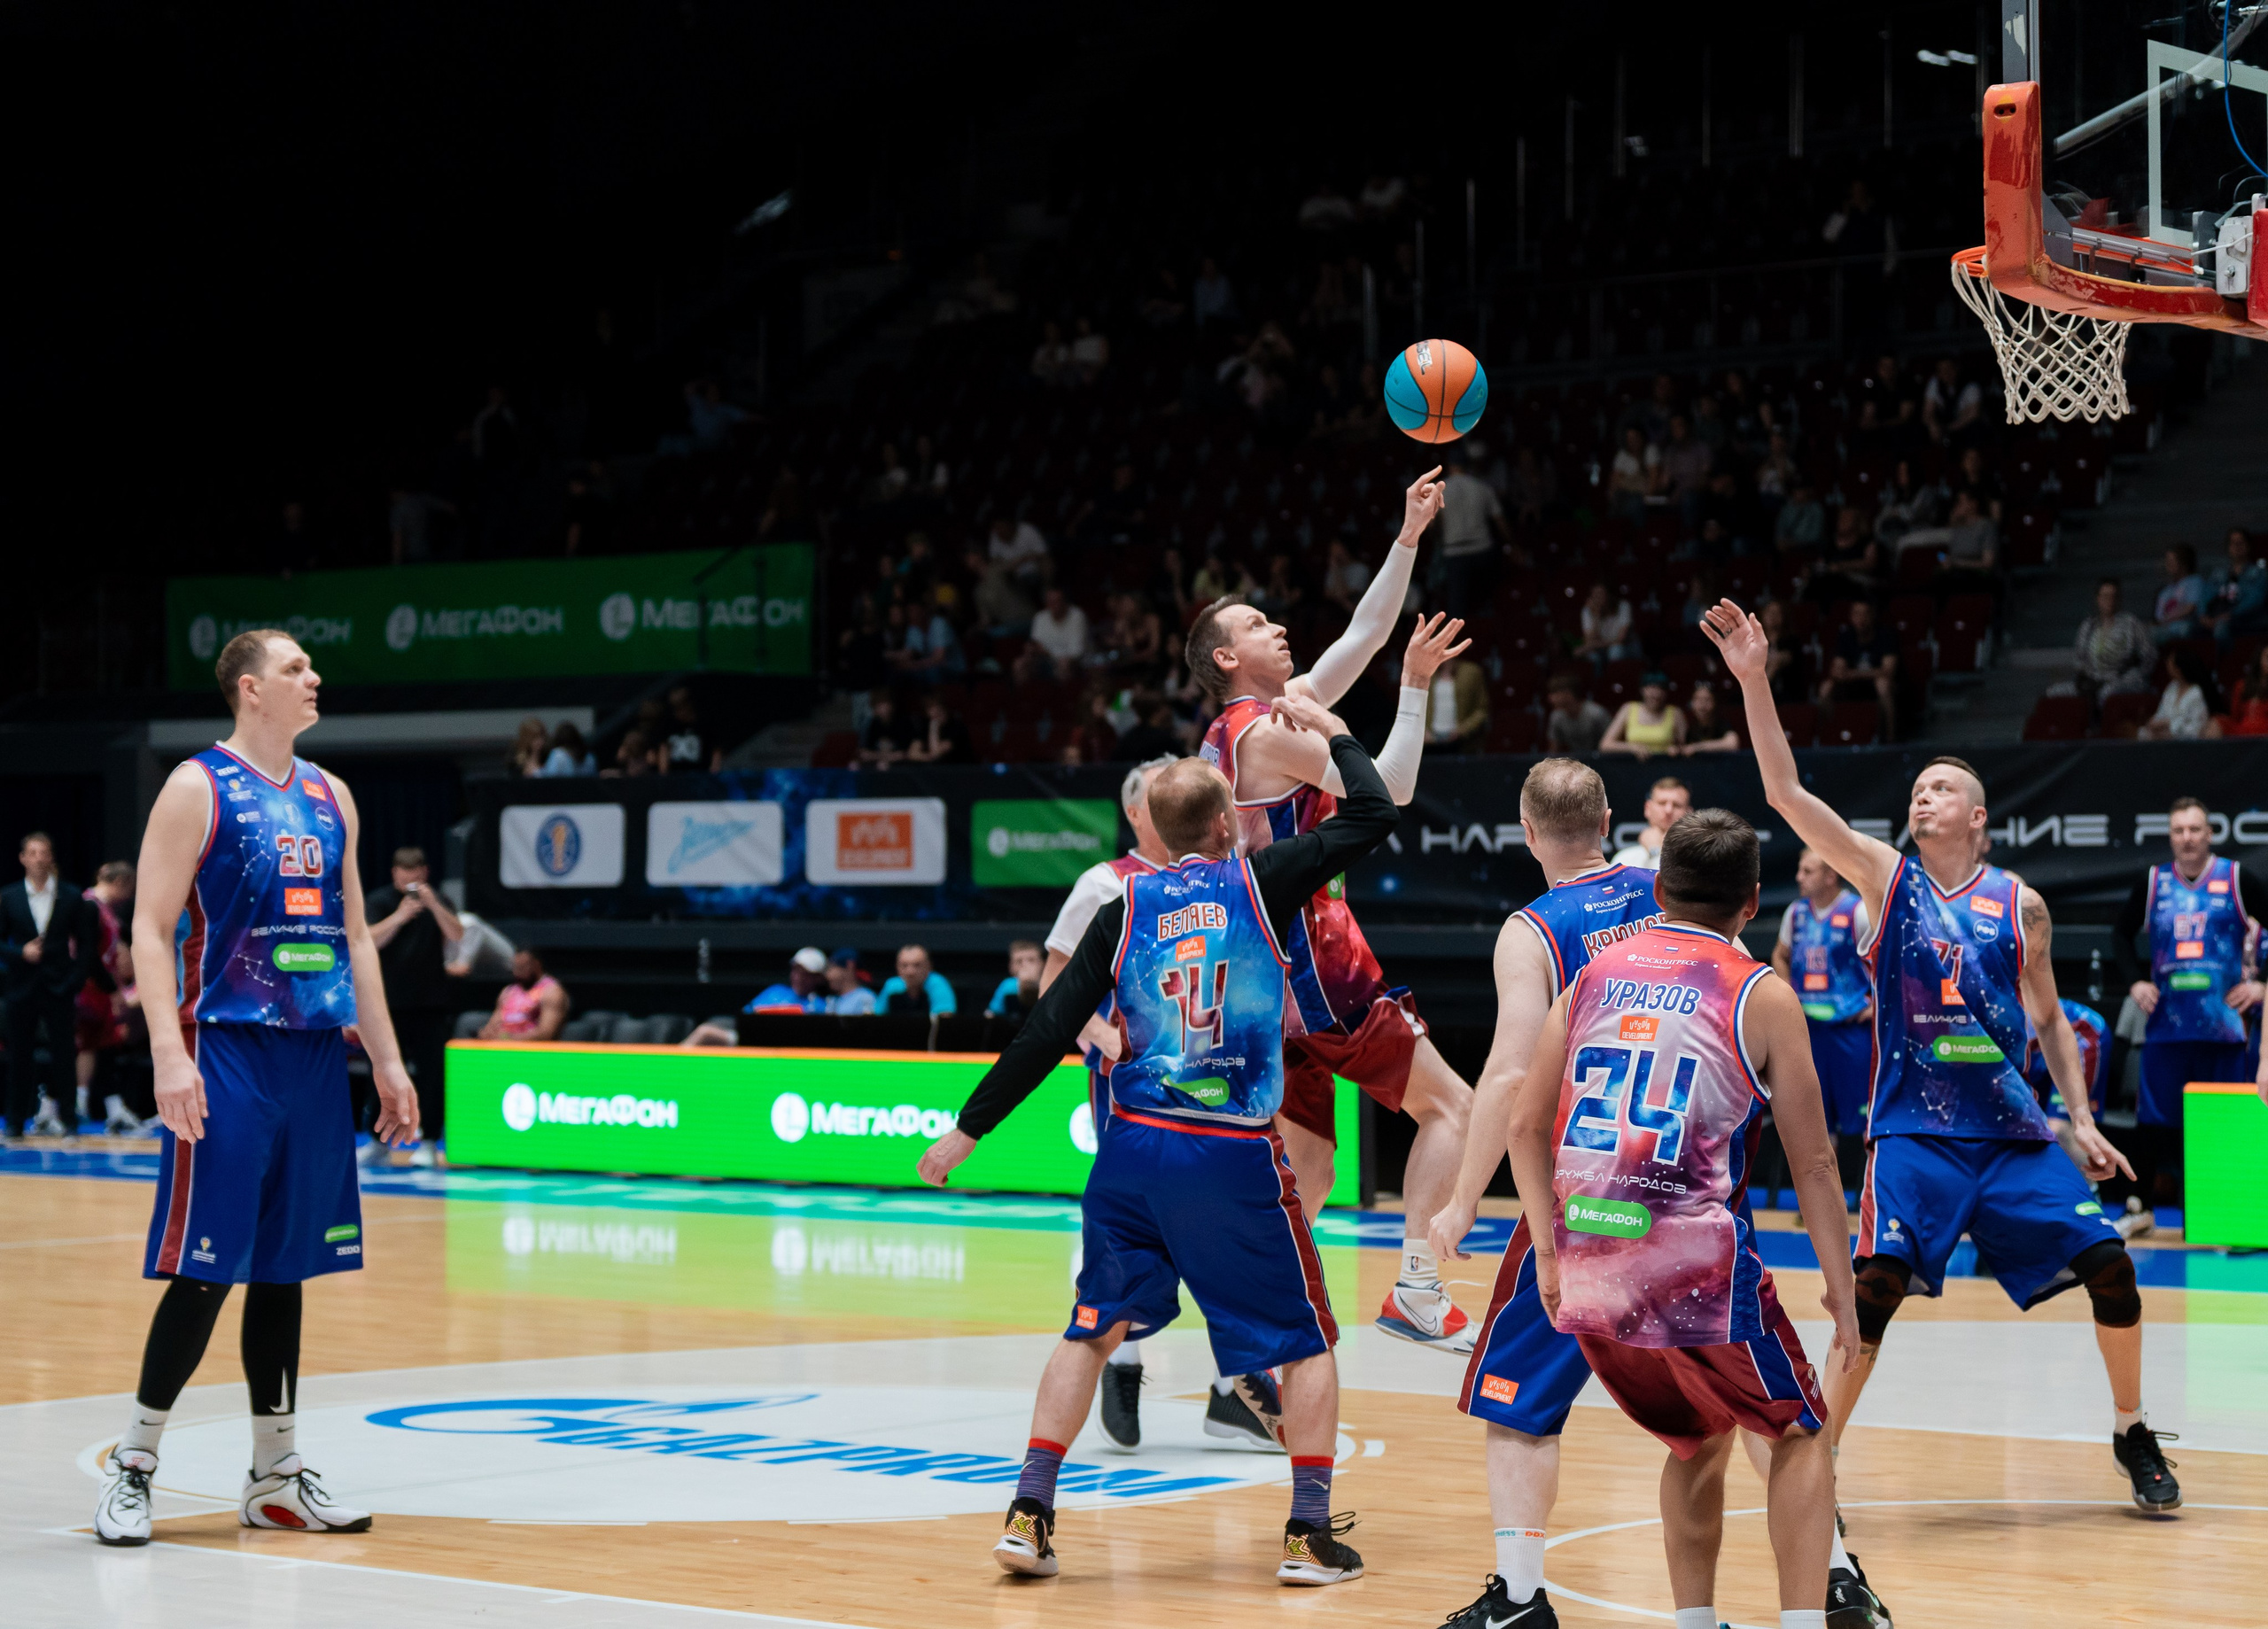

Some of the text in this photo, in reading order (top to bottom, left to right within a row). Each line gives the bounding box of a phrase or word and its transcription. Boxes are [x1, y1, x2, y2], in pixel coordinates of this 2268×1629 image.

[275, 834, 323, 878] 20
[1593, 888, 1645, 910] РОСКОНГРЕСС
[251, 925, 307, 937] ВЕЛИЧИЕ
[1157, 902, 1228, 942] БЕЛЯЕВ
[1637, 956, 1698, 966] РОСКОНГРЕСС
[1930, 936, 1964, 987] 71
[1158, 959, 1230, 1056] 14
[1598, 977, 1702, 1017] УРАЗОВ
[1621, 1031, 1654, 1041] DEVELOPMENT
[1188, 1087, 1223, 1099] ГАФОН
[538, 1091, 679, 1129] МЕГАФОН
[1559, 1043, 1702, 1167] 24
[1608, 1174, 1687, 1195] НАРОДОВ
[1580, 1208, 1643, 1227] МЕГАФОН
[1481, 1388, 1511, 1402] DEVELOPMENT
[535, 1426, 1251, 1498] GAZPROM
[1525, 1530, 1544, 1539] DDX
